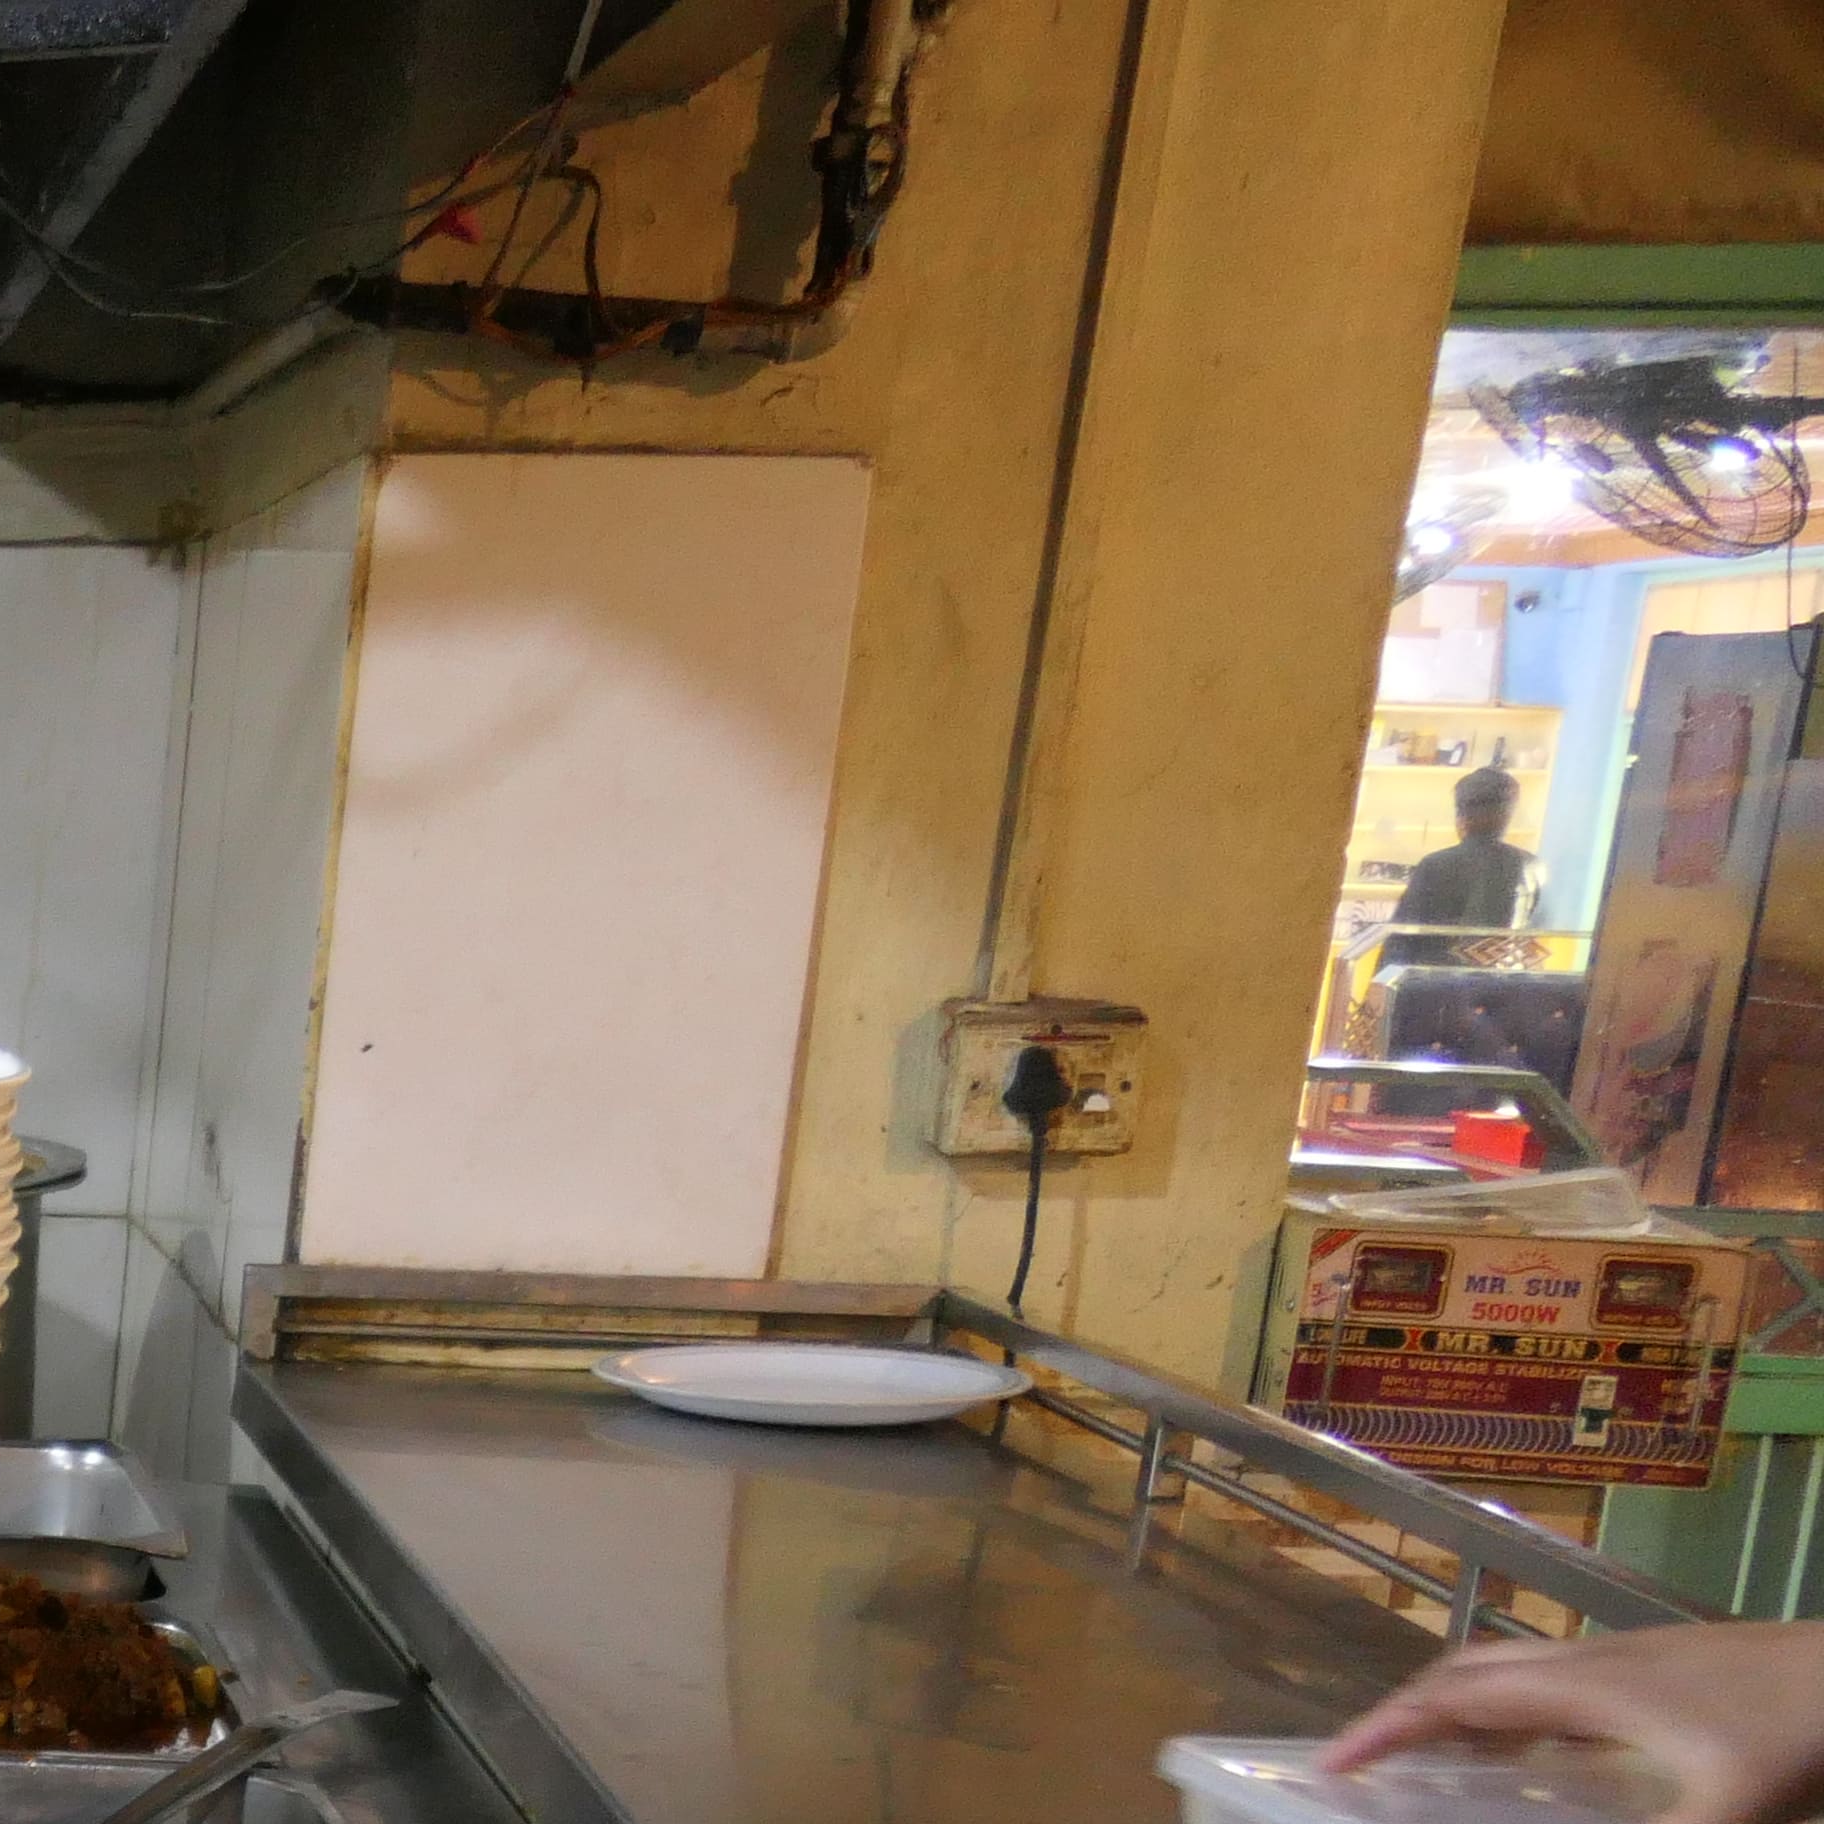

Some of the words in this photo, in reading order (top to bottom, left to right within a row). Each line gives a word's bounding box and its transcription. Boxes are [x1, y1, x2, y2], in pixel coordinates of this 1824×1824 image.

[1525, 1278, 1581, 1298] SUN
[1470, 1302, 1560, 1324] 5000W
[1435, 1331, 1498, 1354] MR.
[1514, 1336, 1588, 1359] SUN
[1407, 1357, 1489, 1376] VOLTAGE
